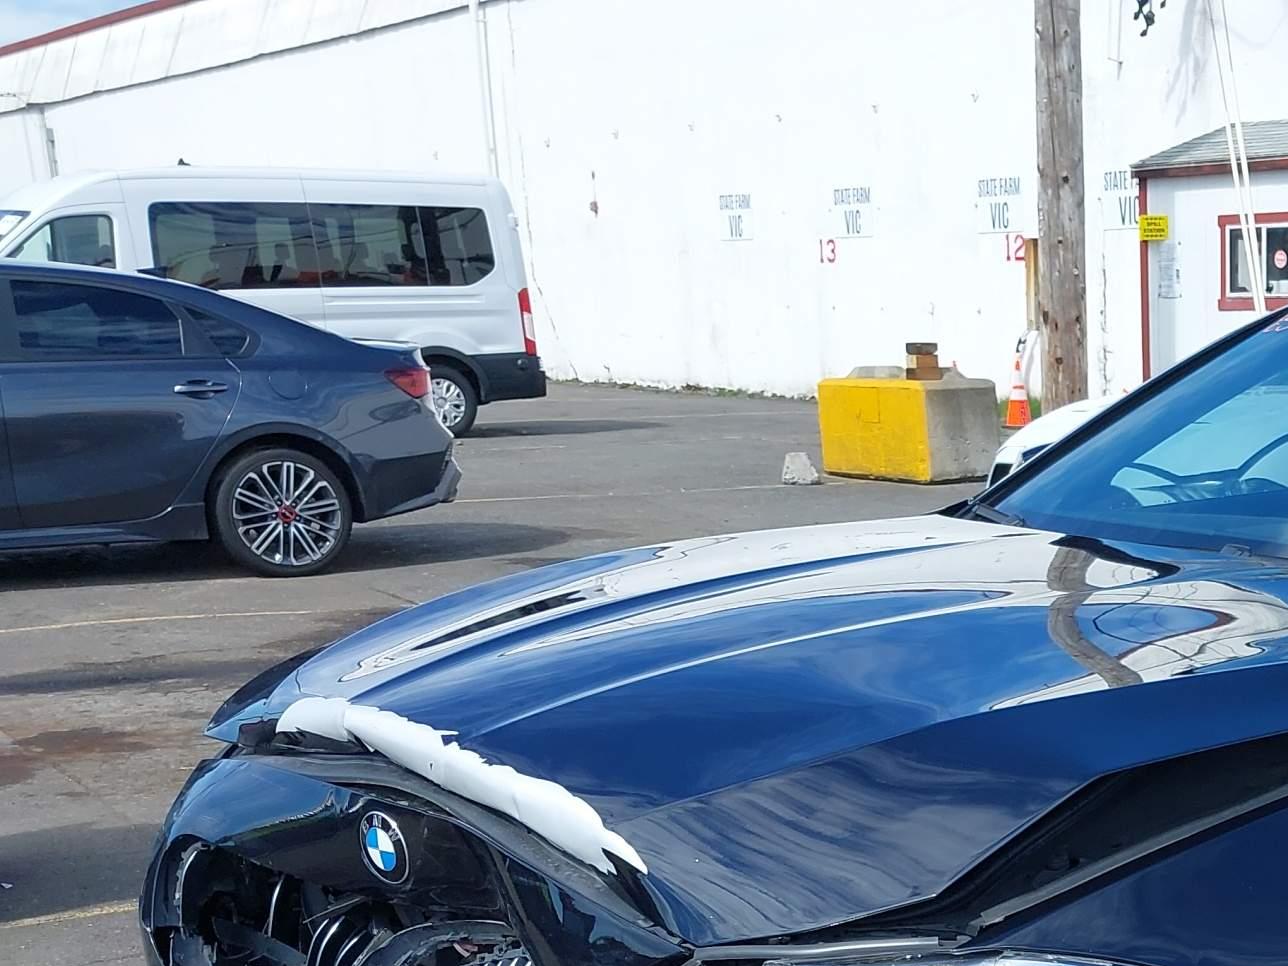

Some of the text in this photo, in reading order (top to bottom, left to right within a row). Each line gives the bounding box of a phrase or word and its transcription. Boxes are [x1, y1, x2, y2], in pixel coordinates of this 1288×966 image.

[978, 176, 1021, 198] STATE FARM
[1103, 171, 1128, 191] STATE
[833, 186, 871, 206] STATE FARM
[728, 214, 744, 238] VIC
[844, 209, 862, 235] VIC
[990, 202, 1010, 230] VIC
[819, 239, 837, 264] 13
[1005, 233, 1025, 262] 12
